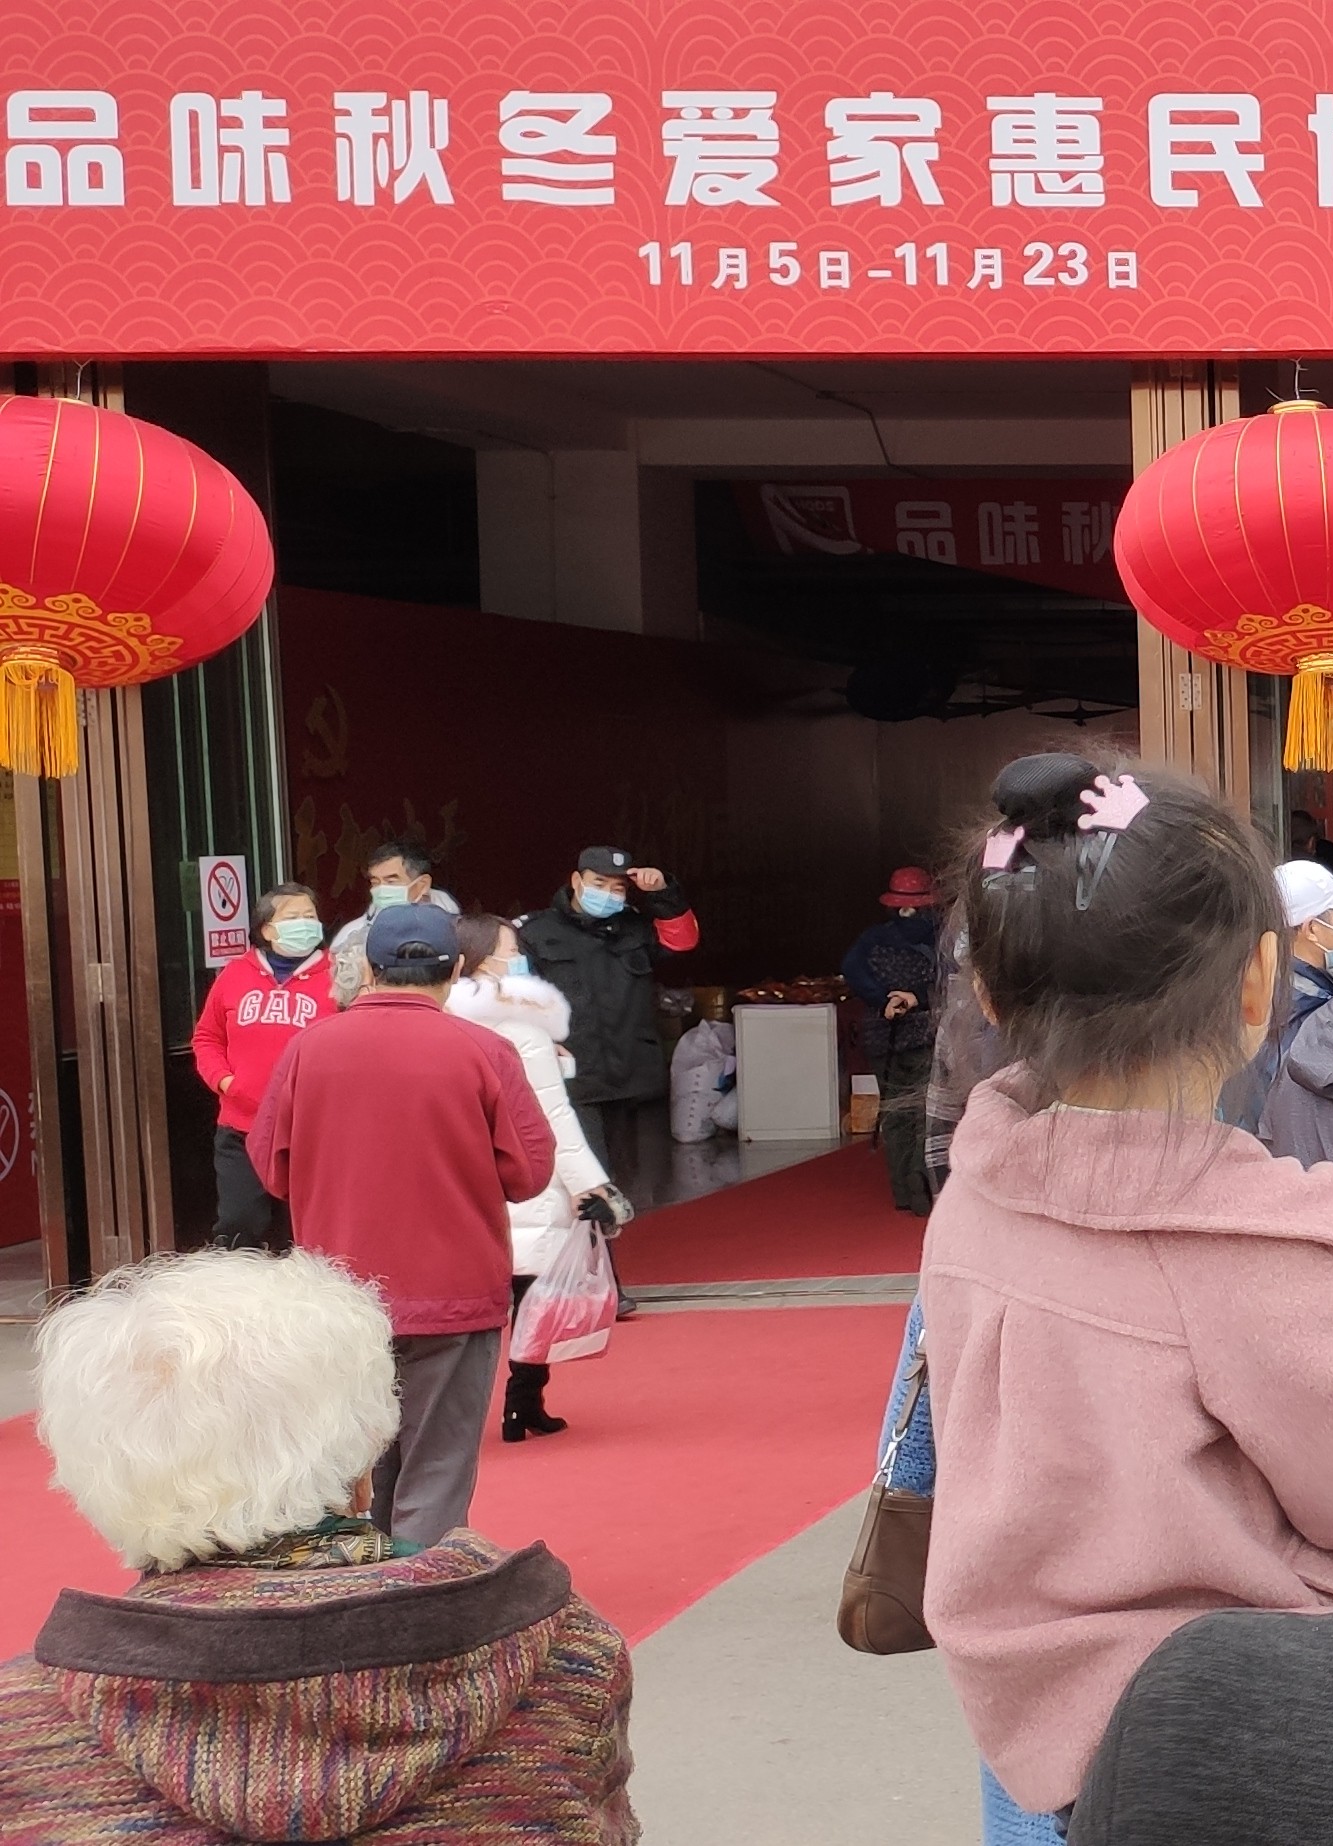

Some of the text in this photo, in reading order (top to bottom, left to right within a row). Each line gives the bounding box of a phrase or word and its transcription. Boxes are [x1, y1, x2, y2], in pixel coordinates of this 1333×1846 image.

[638, 242, 1139, 289] 11月5日-11月23日
[238, 989, 317, 1028] GAP
